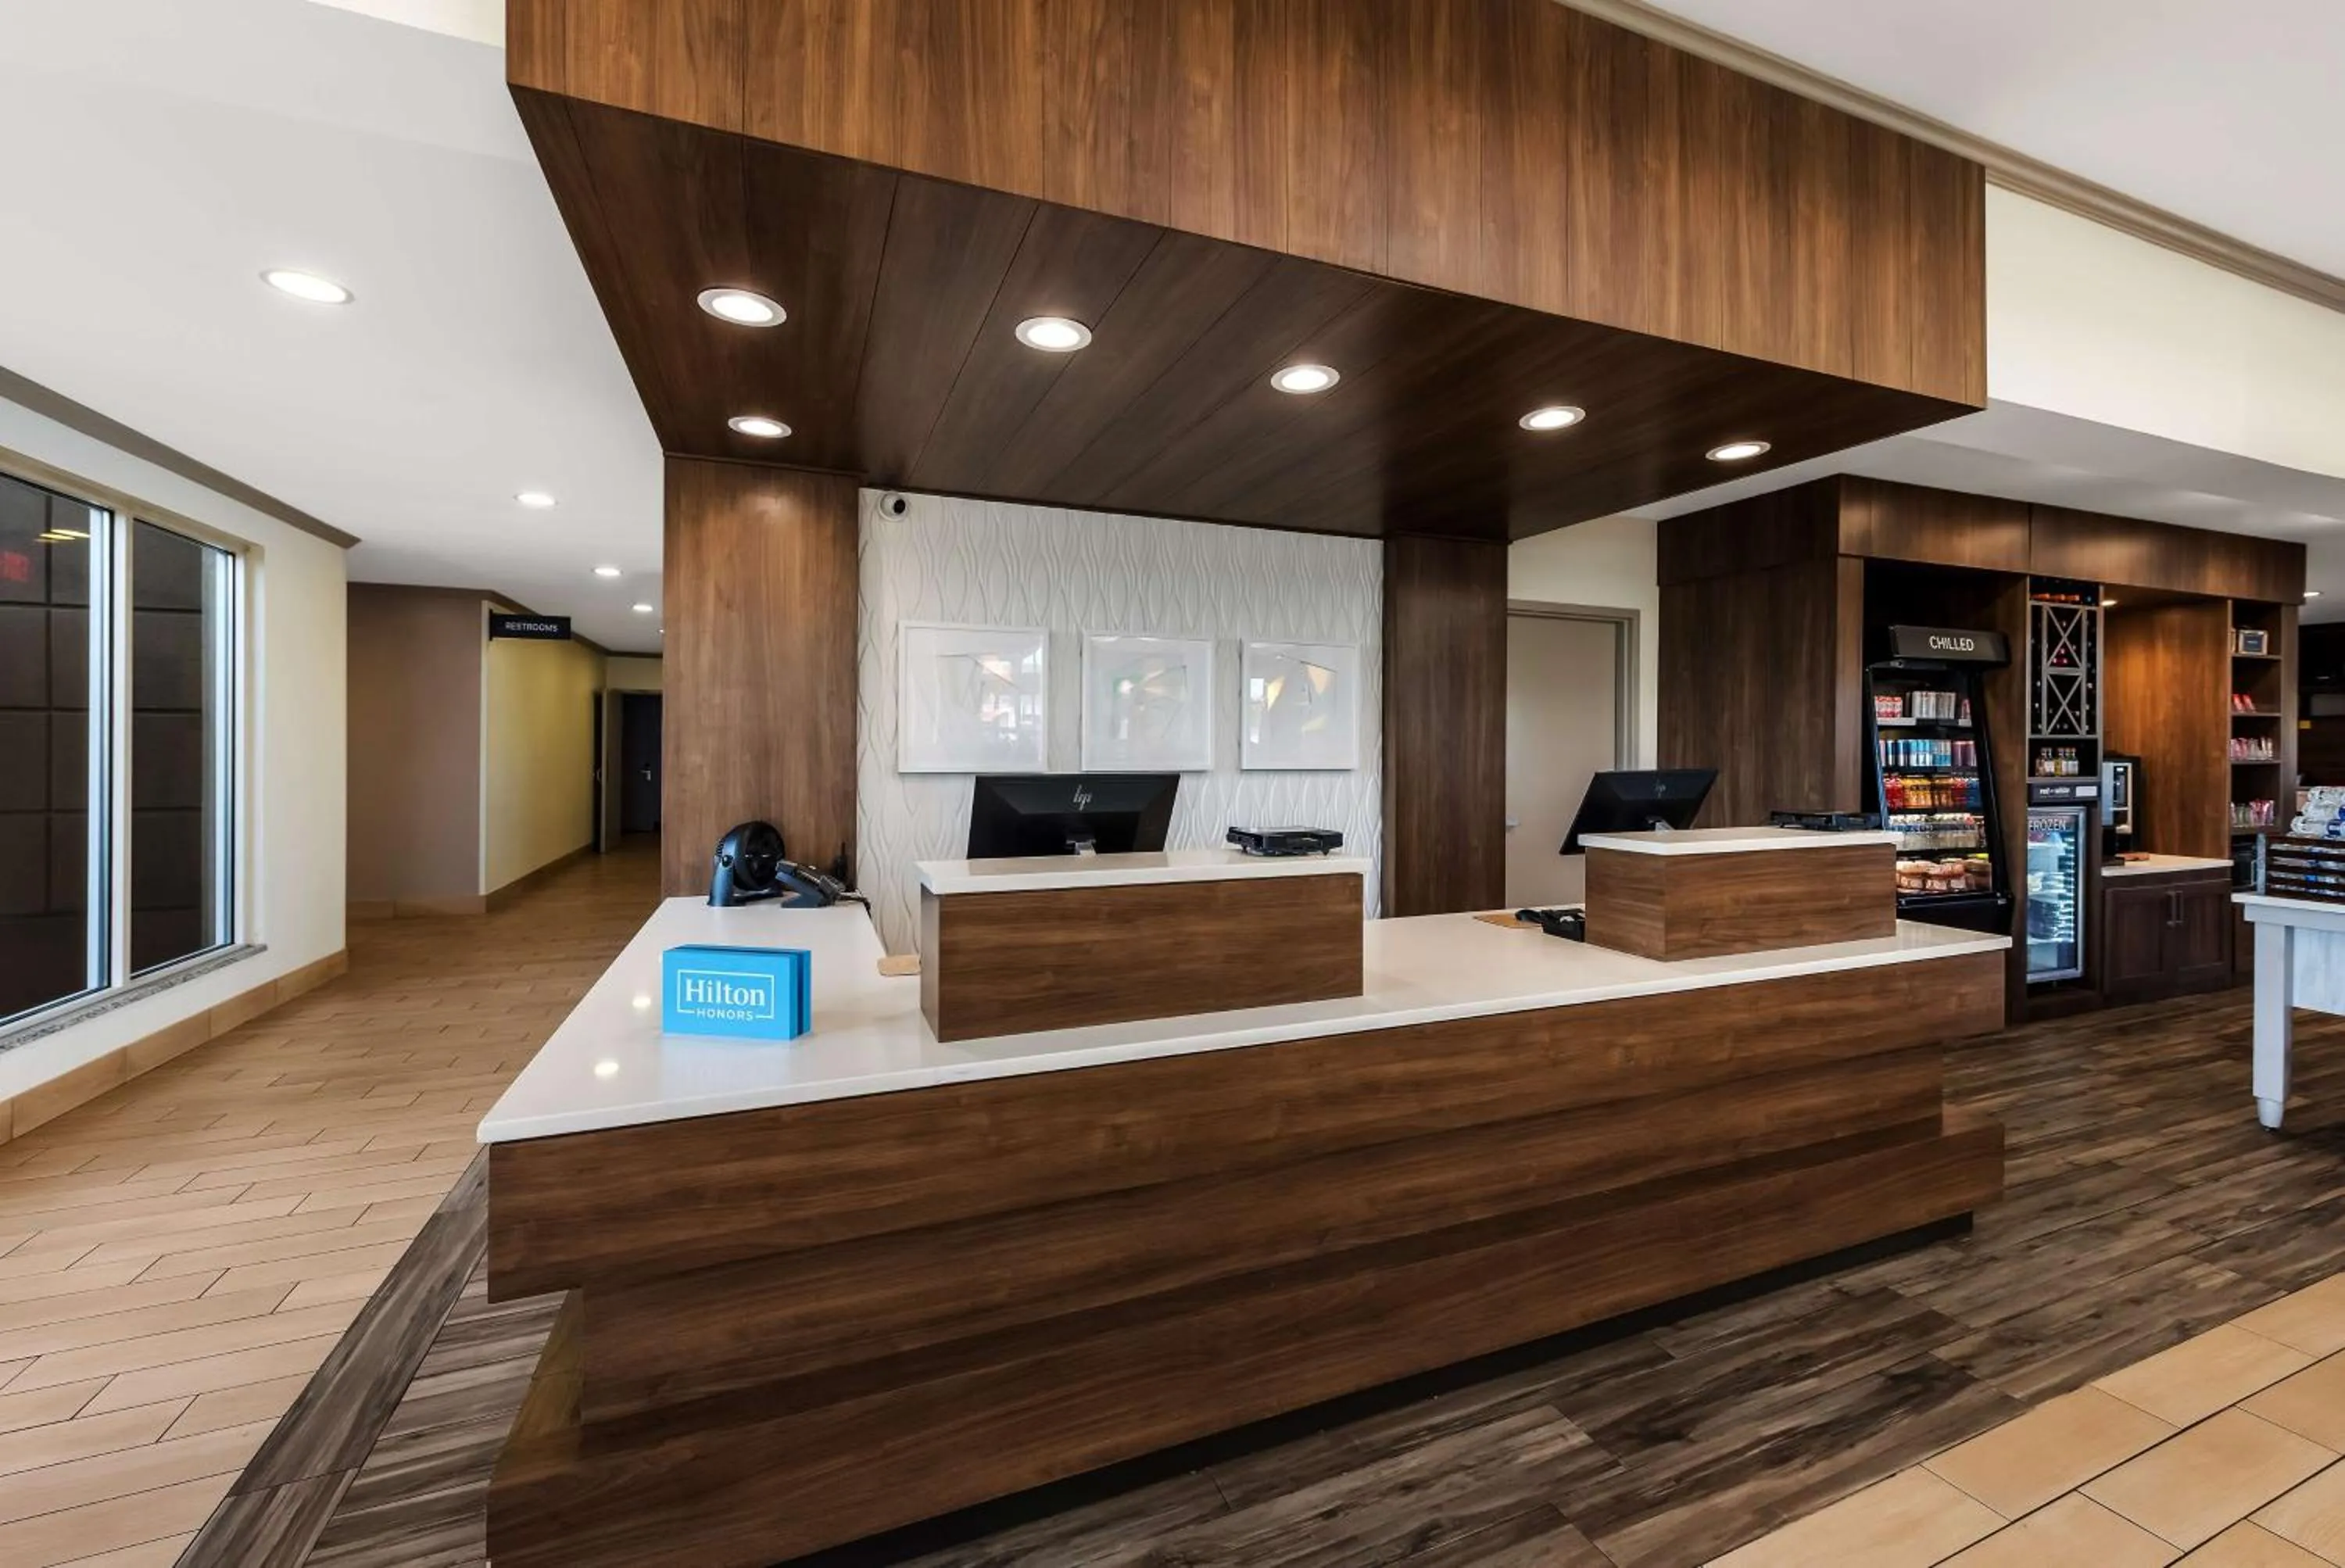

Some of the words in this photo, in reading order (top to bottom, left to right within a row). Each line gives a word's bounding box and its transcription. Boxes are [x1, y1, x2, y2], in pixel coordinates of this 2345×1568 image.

[505, 621, 559, 632] RESTROOMS
[1929, 635, 1974, 651] CHILLED
[1072, 784, 1092, 811] hp
[2028, 818, 2066, 831] FROZEN
[685, 978, 766, 1007] Hilton
[696, 1008, 754, 1022] HONORS
